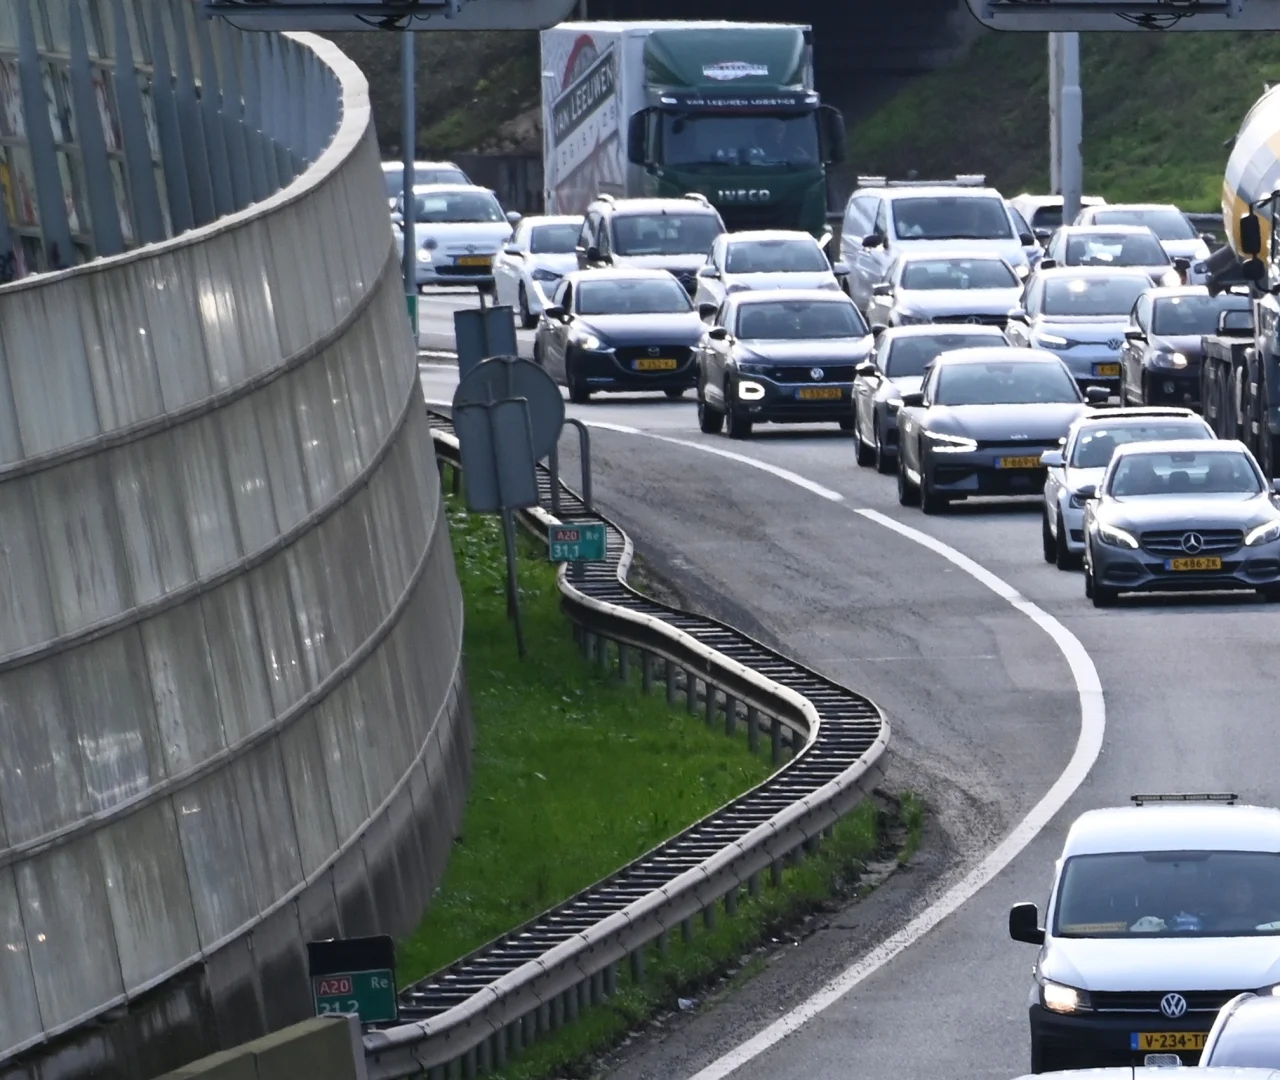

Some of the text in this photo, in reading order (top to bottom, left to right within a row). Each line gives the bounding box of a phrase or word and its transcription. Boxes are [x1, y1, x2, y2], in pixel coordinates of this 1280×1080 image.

[718, 190, 770, 200] IVECO
[557, 530, 577, 540] A20
[554, 545, 579, 559] 31,1
[320, 977, 389, 995] A20 Re
[320, 1000, 359, 1014] 312
